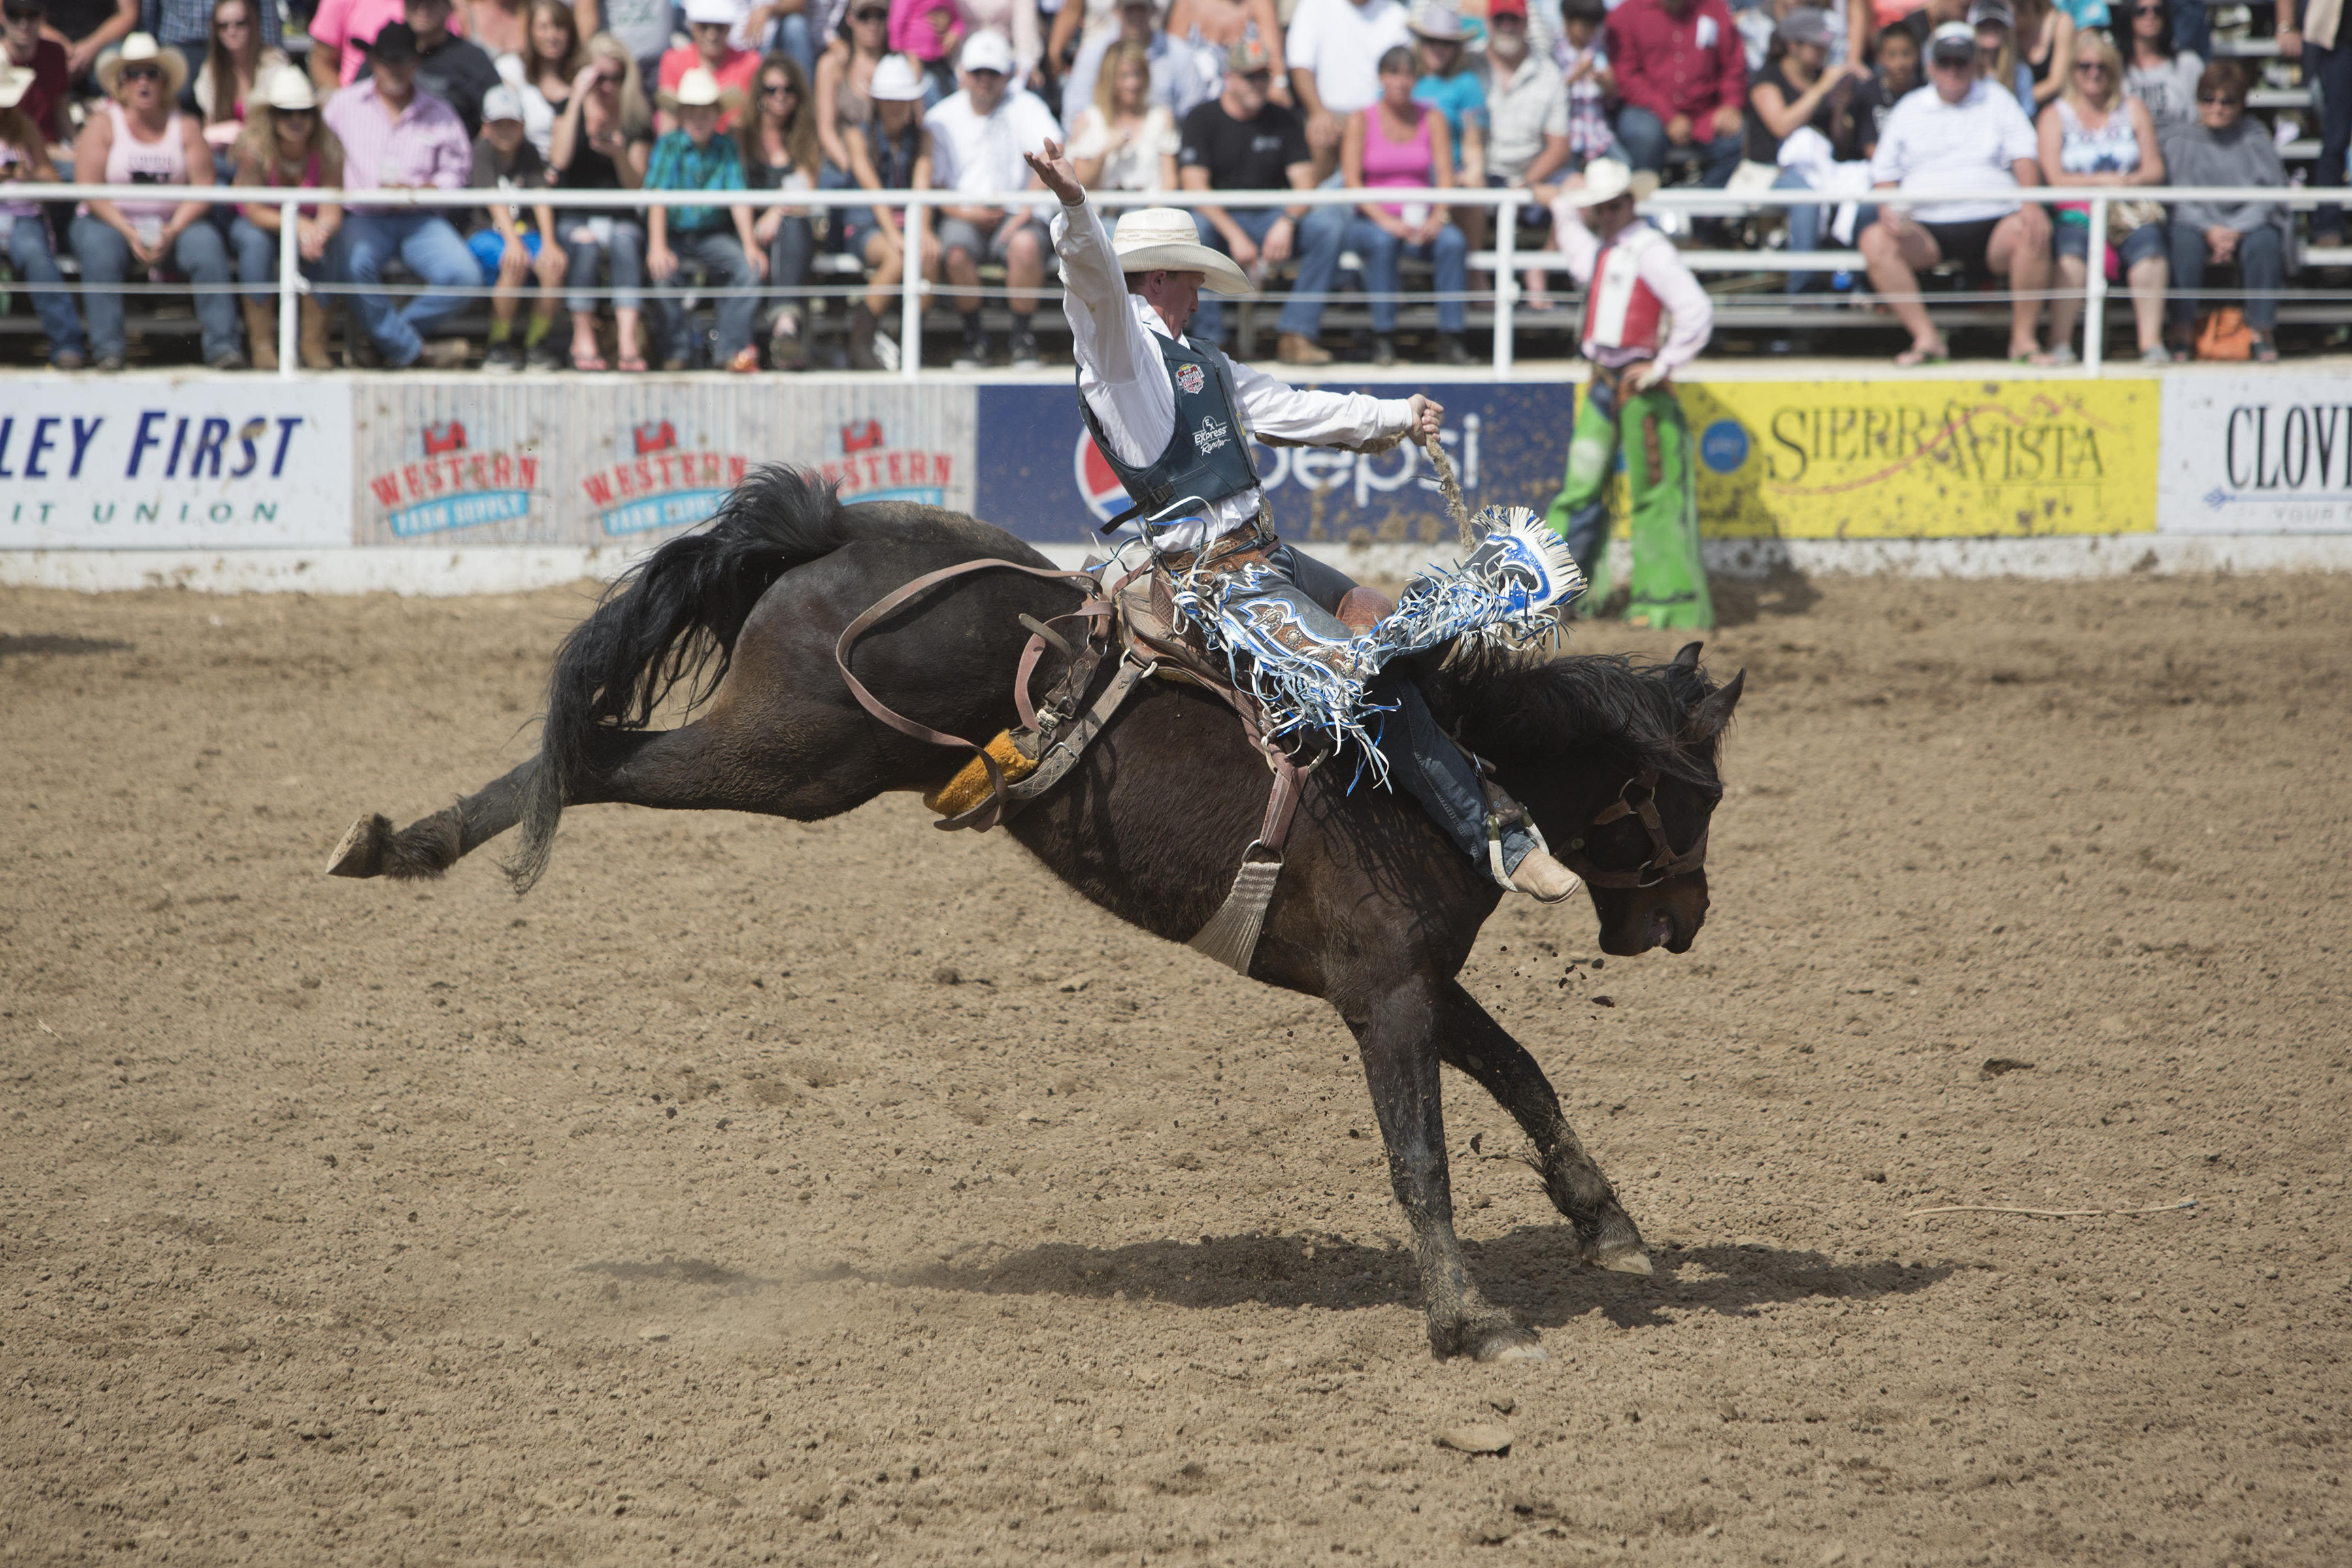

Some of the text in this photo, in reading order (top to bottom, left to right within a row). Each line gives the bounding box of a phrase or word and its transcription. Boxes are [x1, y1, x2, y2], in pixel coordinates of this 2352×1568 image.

[125, 411, 304, 479] FIRST
[1765, 399, 2104, 484] SIERRA VISTA
[371, 451, 538, 508] WESTERN
[582, 450, 747, 507] WESTERN
[93, 500, 278, 523] UNION
